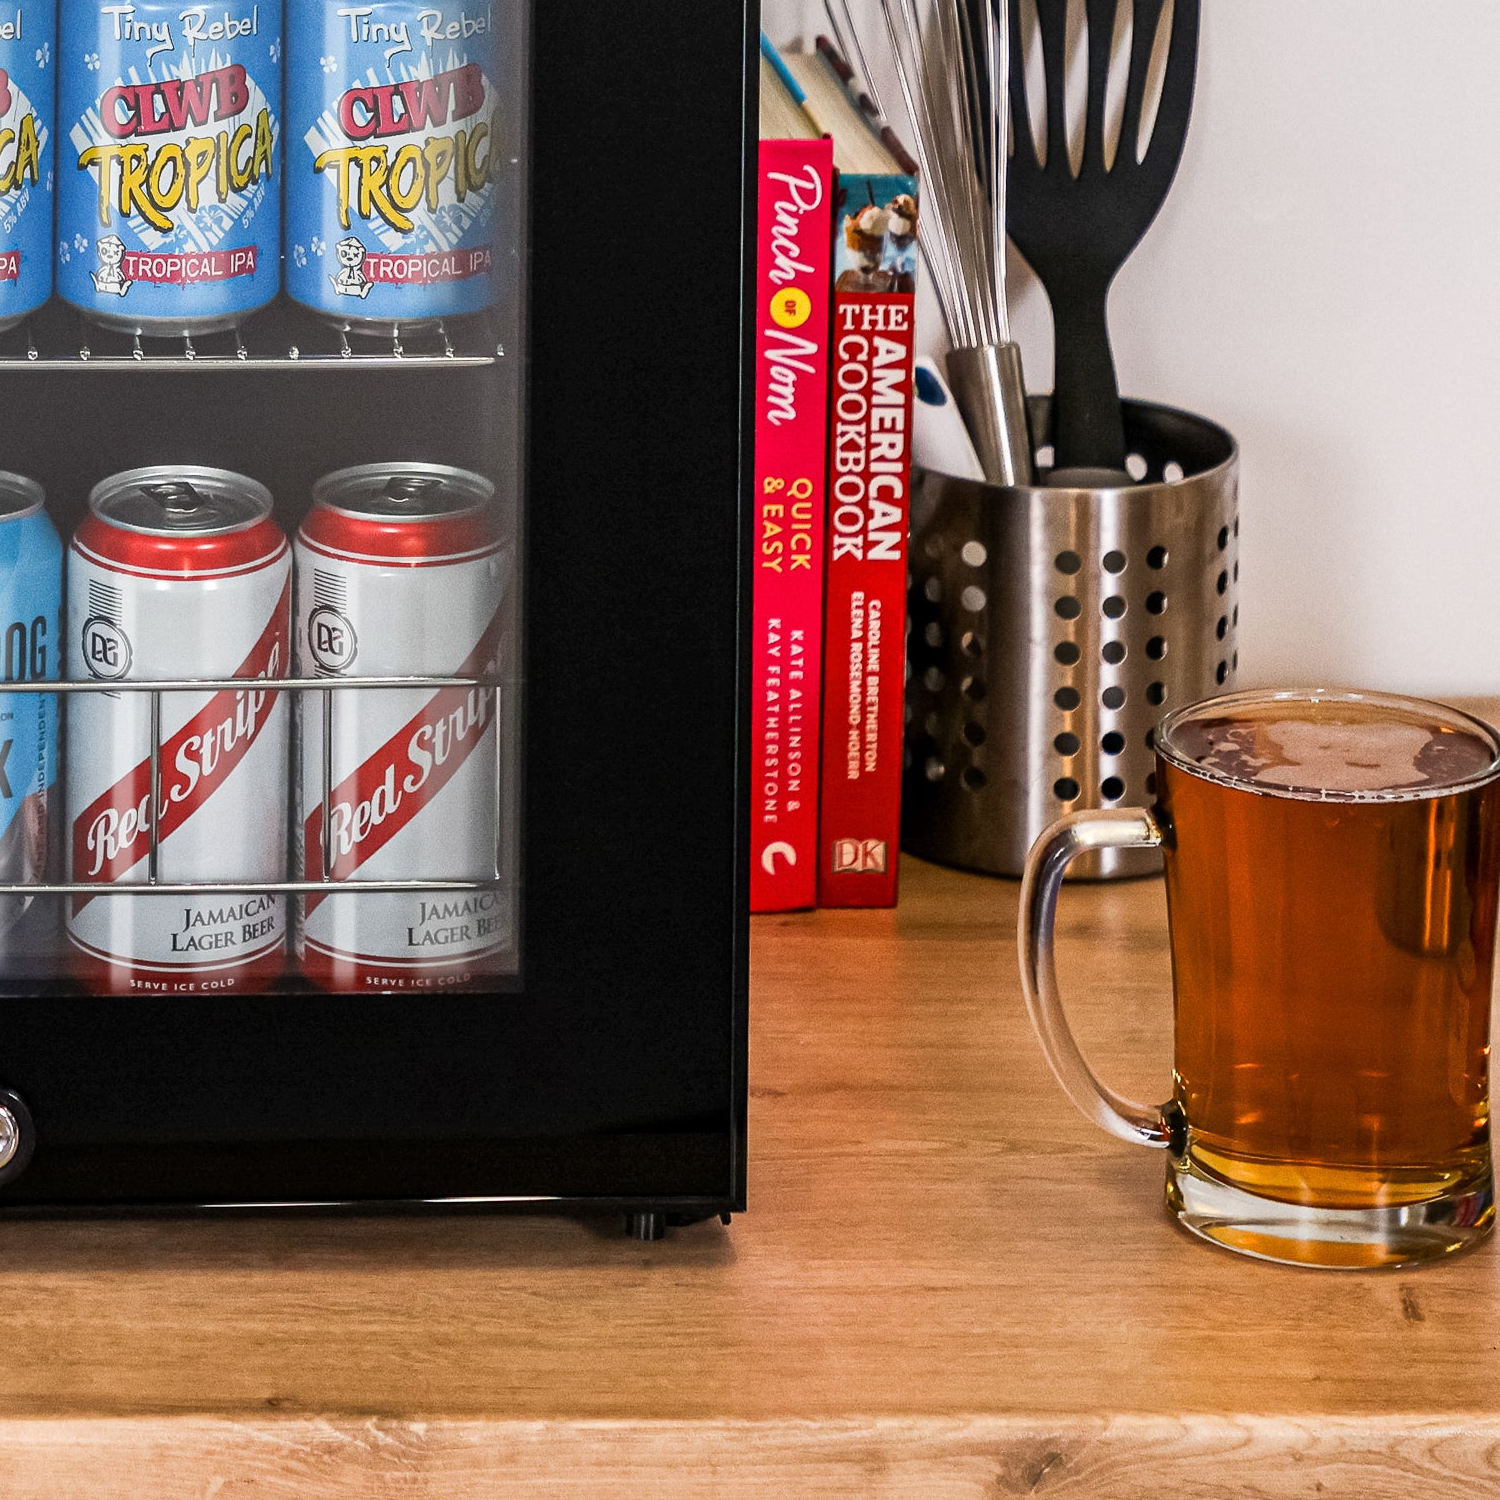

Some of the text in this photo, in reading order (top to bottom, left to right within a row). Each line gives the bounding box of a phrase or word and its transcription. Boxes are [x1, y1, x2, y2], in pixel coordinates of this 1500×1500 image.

[101, 4, 258, 67] Tiny Rebel
[337, 3, 491, 68] Tiny Rebel
[99, 64, 249, 140] CLWB
[337, 63, 485, 141] CLWB
[77, 107, 274, 234] TROPICA
[767, 164, 823, 285] Pinch
[126, 251, 255, 278] TROPICAL IPA
[367, 251, 491, 278] TROPICAL IPA
[784, 299, 797, 317] OF
[838, 303, 909, 332] THE
[764, 328, 818, 427] Nom
[832, 334, 869, 561] COOKBOOK
[866, 336, 908, 561] AMERICAN
[761, 476, 785, 574] & EASY
[786, 477, 813, 571] QUICK
[788, 629, 804, 681] KATE
[866, 599, 882, 673] CAROLINE
[763, 617, 782, 824] KAY FEATHERSTONE
[786, 688, 803, 792] ALLINSON
[320, 763, 403, 870] Red
[836, 840, 886, 870] DK
[171, 916, 276, 952] LAGER BEER
[182, 894, 276, 932] JAMAICAN
[407, 915, 501, 947] LAGER BE
[419, 893, 500, 926] JAMAIC
[129, 978, 236, 991] SERVE ICE COLD
[365, 973, 471, 987] SERVE ICE COLD
